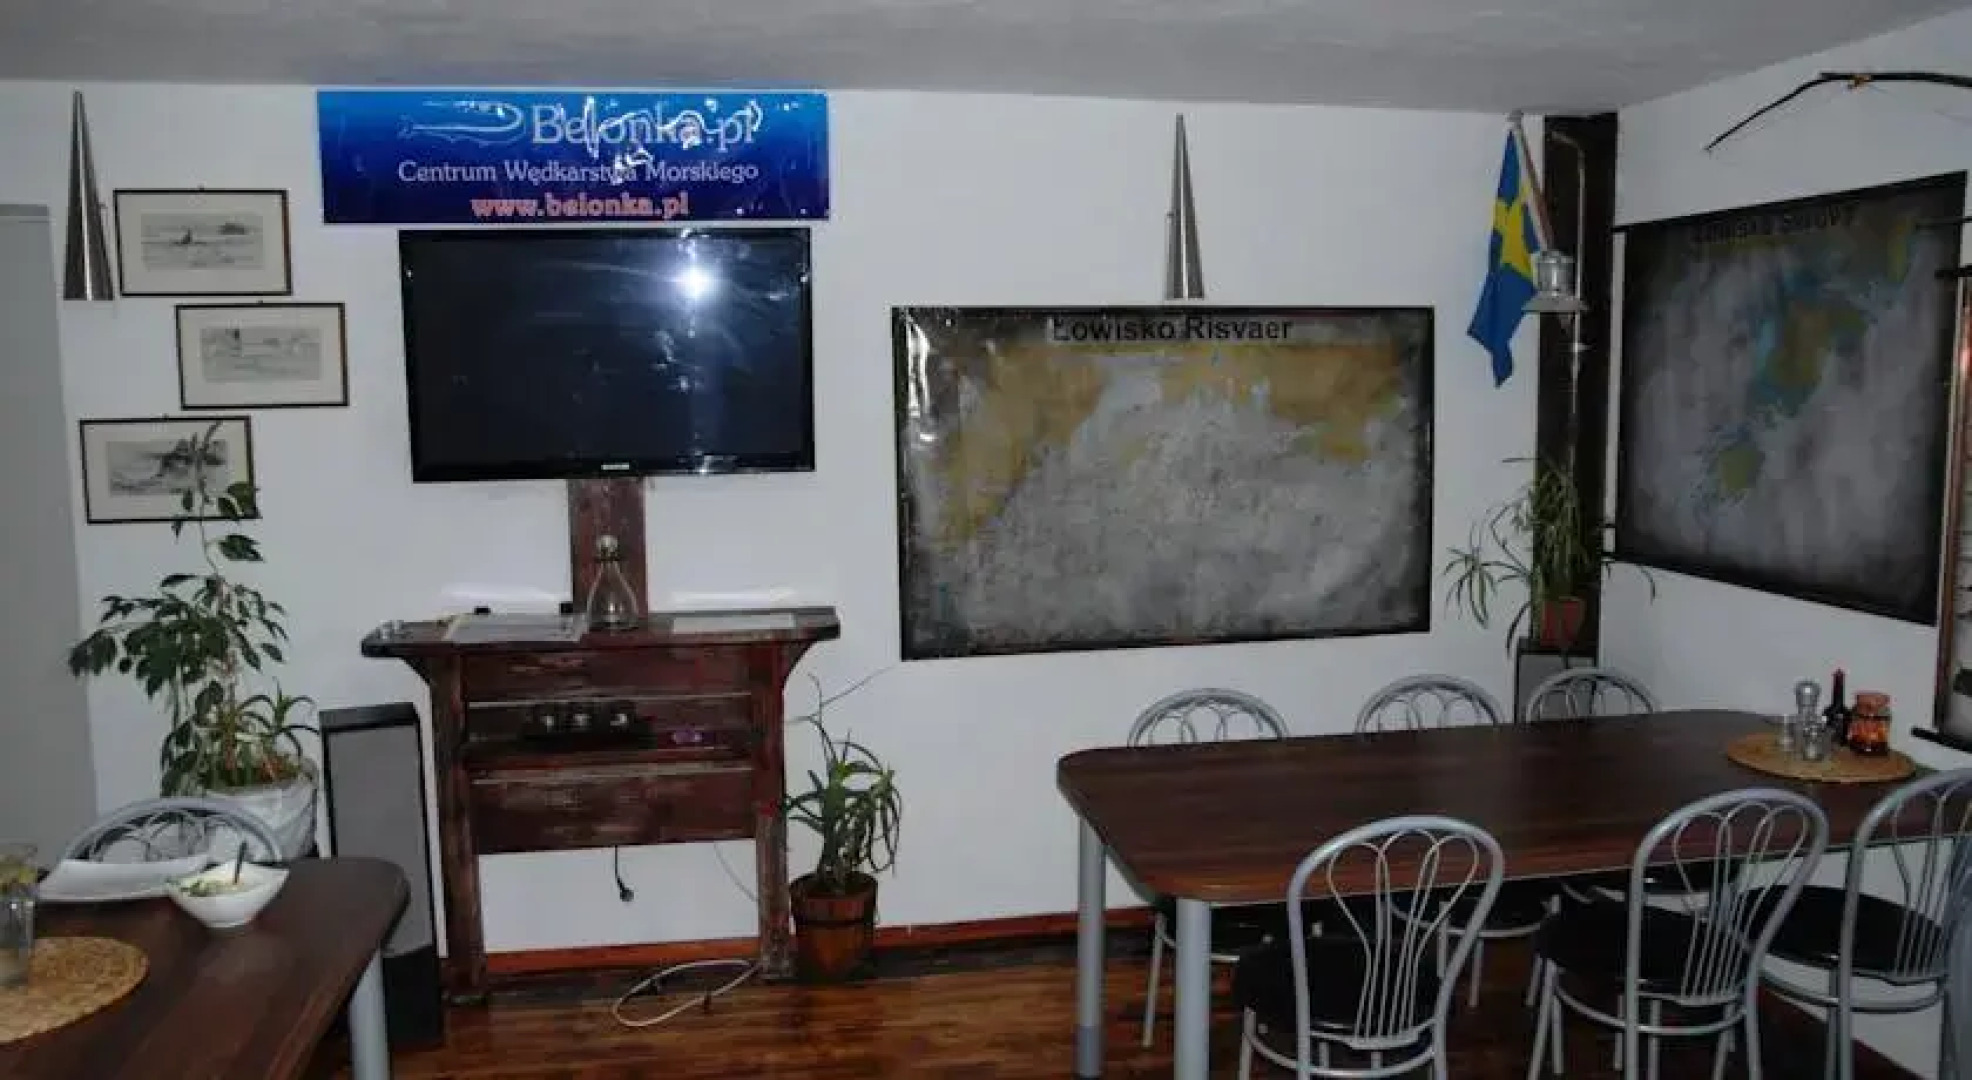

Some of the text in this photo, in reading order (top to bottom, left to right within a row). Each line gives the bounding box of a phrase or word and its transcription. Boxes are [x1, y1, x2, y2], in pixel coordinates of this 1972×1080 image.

[532, 101, 755, 151] Belonka.pl
[399, 160, 496, 183] Centrum
[646, 161, 759, 184] Morskiego
[470, 191, 690, 219] www.belonka.pl
[1186, 314, 1293, 340] Risvaer
